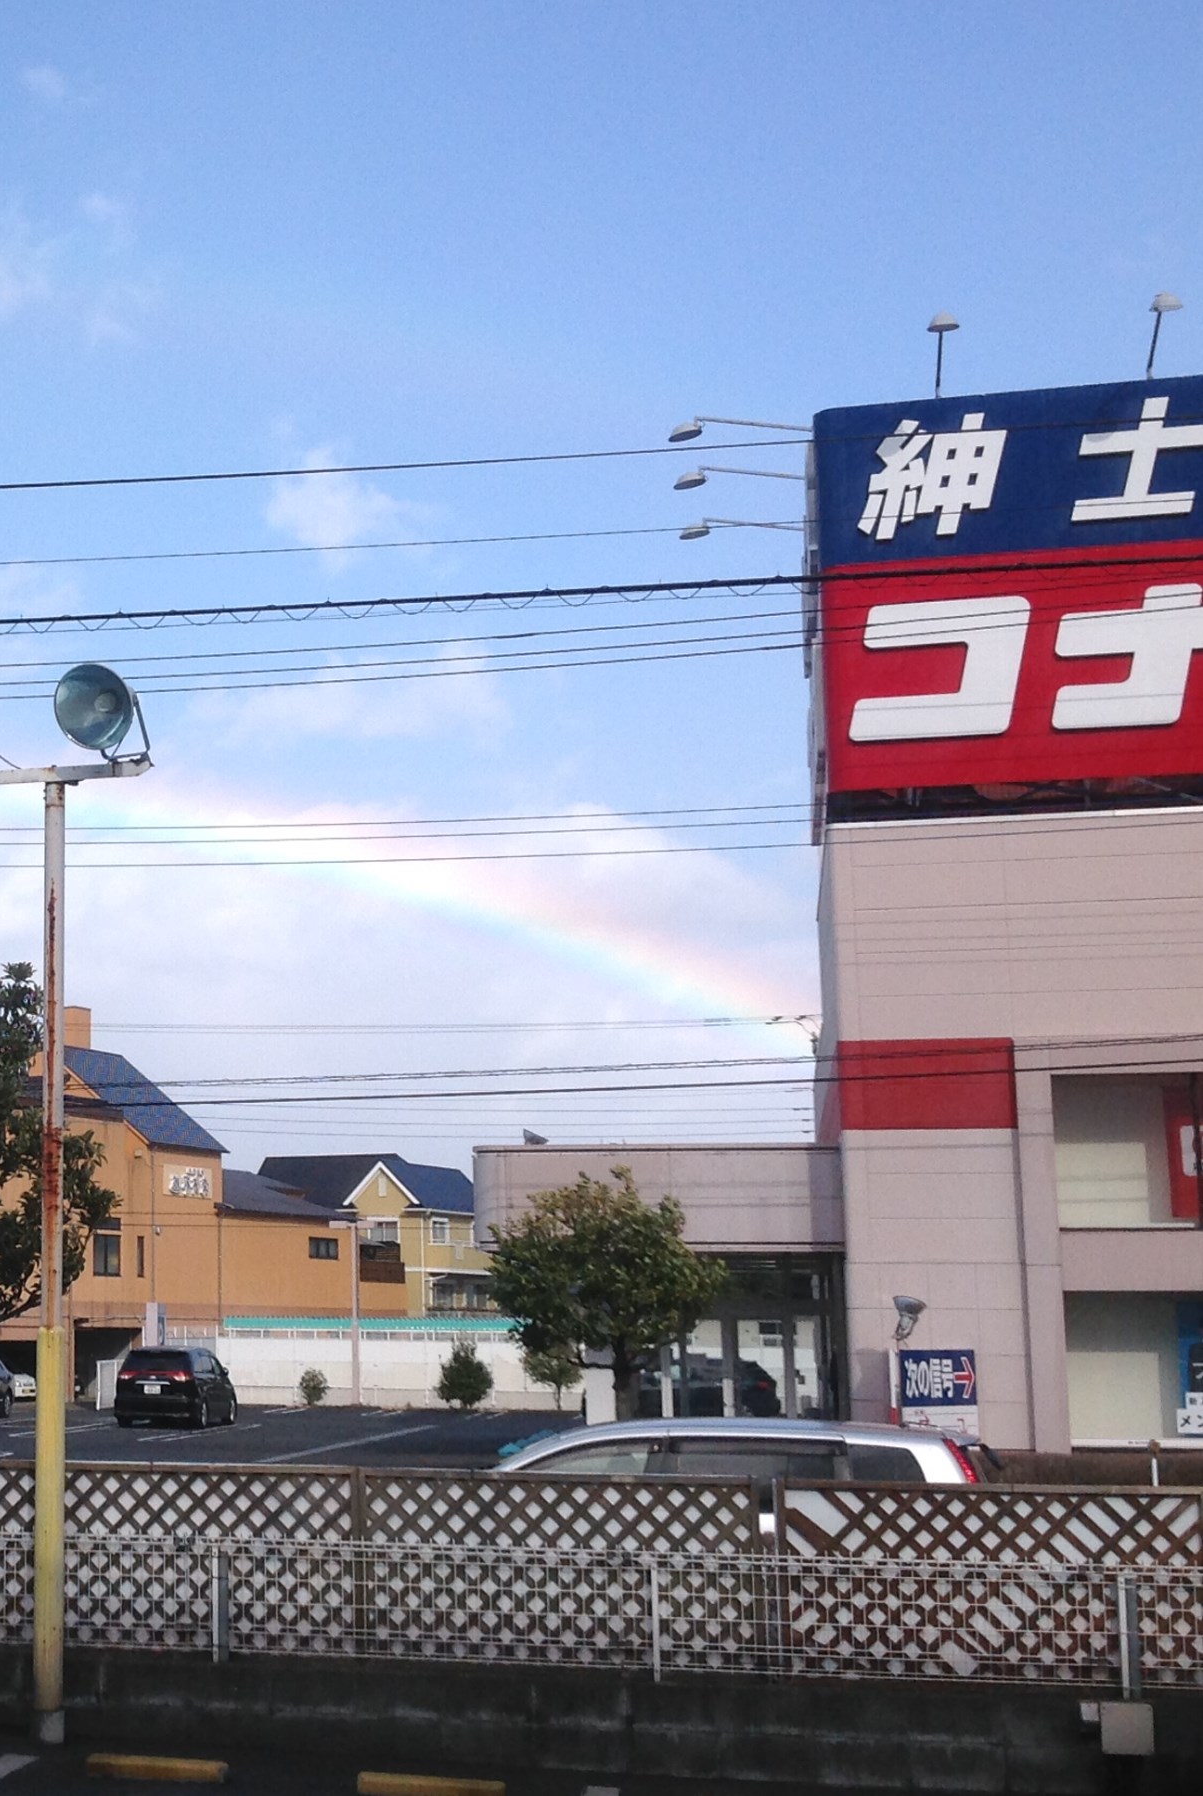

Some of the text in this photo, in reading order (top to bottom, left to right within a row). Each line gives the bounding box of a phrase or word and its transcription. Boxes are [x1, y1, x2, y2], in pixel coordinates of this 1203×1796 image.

[856, 396, 1203, 541] 紳士
[848, 582, 1203, 742] コナ
[904, 1358, 953, 1398] 次の信号
